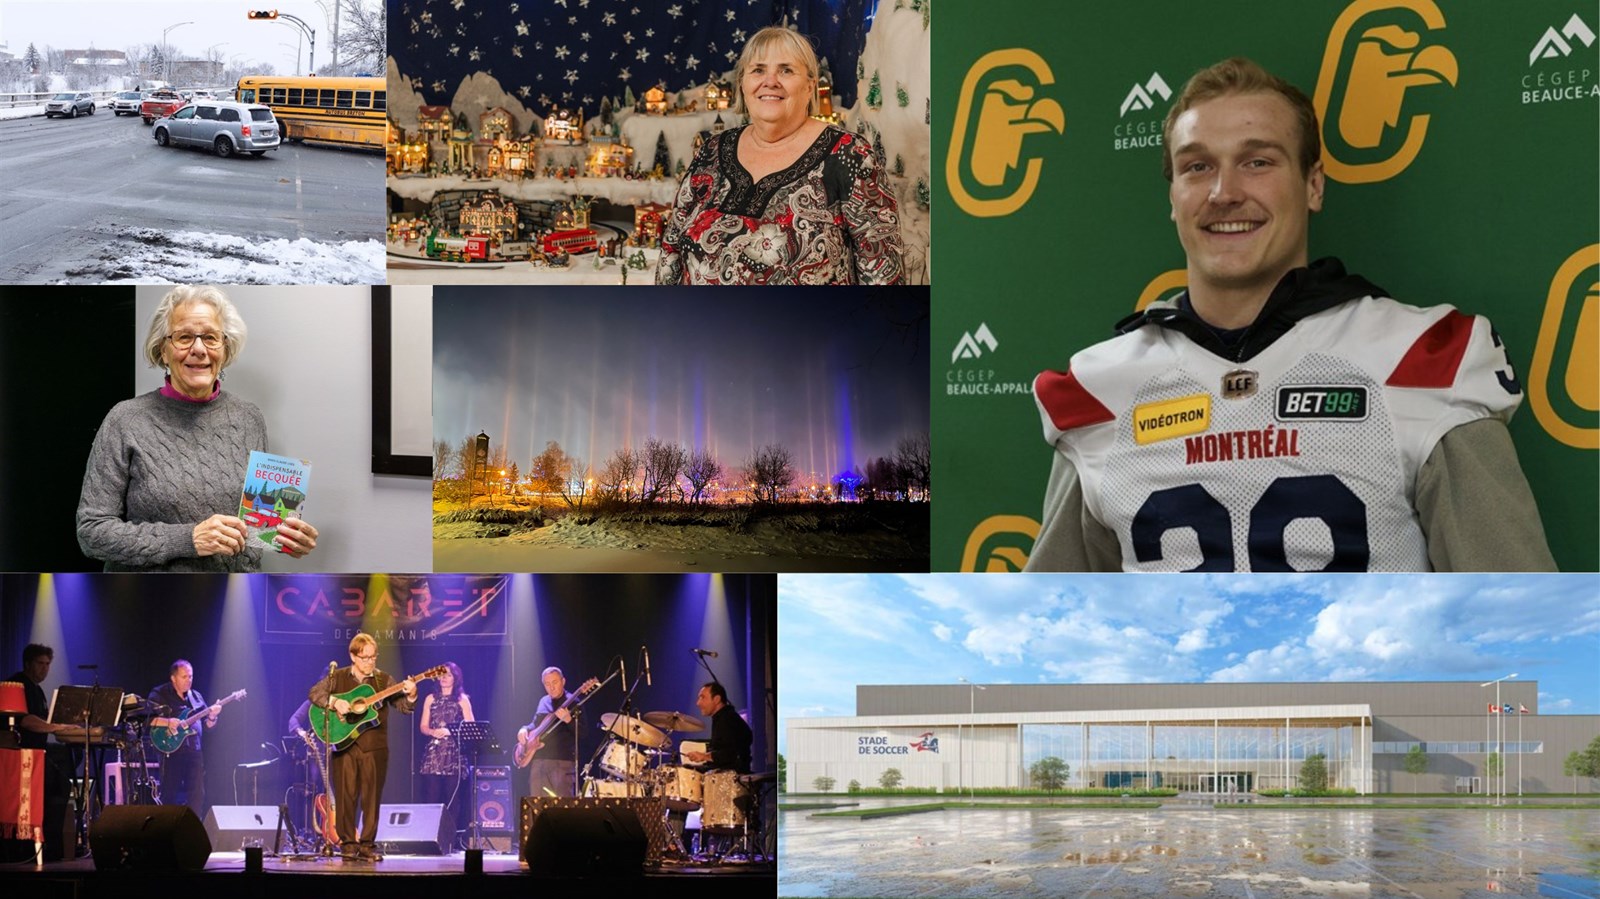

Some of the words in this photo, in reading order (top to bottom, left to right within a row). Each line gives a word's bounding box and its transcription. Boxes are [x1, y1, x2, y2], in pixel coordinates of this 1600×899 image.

[1522, 69, 1590, 88] CÉGEP
[946, 369, 995, 382] CÉGEP
[1227, 378, 1252, 391] LCF
[1285, 392, 1353, 413] BET99
[1138, 408, 1204, 432] VIDÉOTRON
[1185, 425, 1300, 465] MONTRÉAL
[256, 462, 303, 476] L'INDISPENSABLE
[255, 469, 301, 486] BECQUÉE
[276, 587, 496, 617] CABARET
[374, 629, 437, 641] AMANTS
[858, 736, 887, 745] STADE
[859, 746, 870, 754] DE
[873, 746, 908, 755] SOCCER
